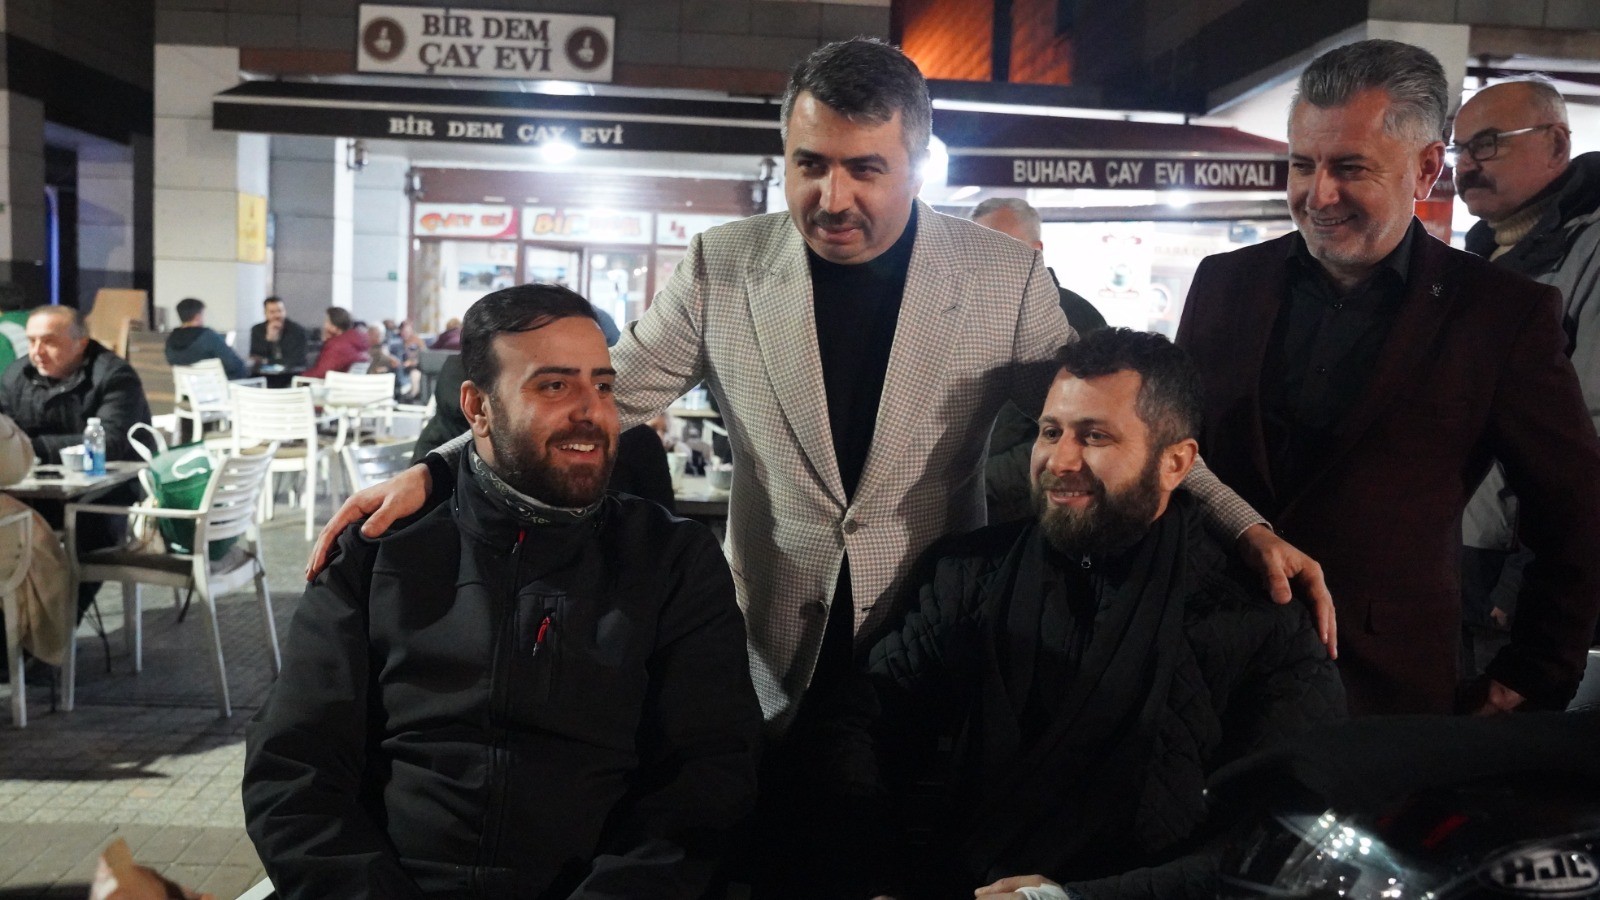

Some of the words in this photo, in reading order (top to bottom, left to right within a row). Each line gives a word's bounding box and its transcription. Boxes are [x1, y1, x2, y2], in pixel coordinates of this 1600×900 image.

[422, 10, 472, 37] BİR
[482, 17, 550, 42] DEM
[418, 42, 483, 74] ÇAY
[494, 41, 551, 72] EVİ
[388, 114, 435, 136] BİR
[446, 121, 504, 139] DEM
[579, 124, 625, 144] EVİ
[1012, 159, 1097, 183] BUHARA
[1104, 162, 1143, 188] ÇAY
[1154, 163, 1186, 185] EVİ
[1193, 163, 1275, 186] KONYALI
